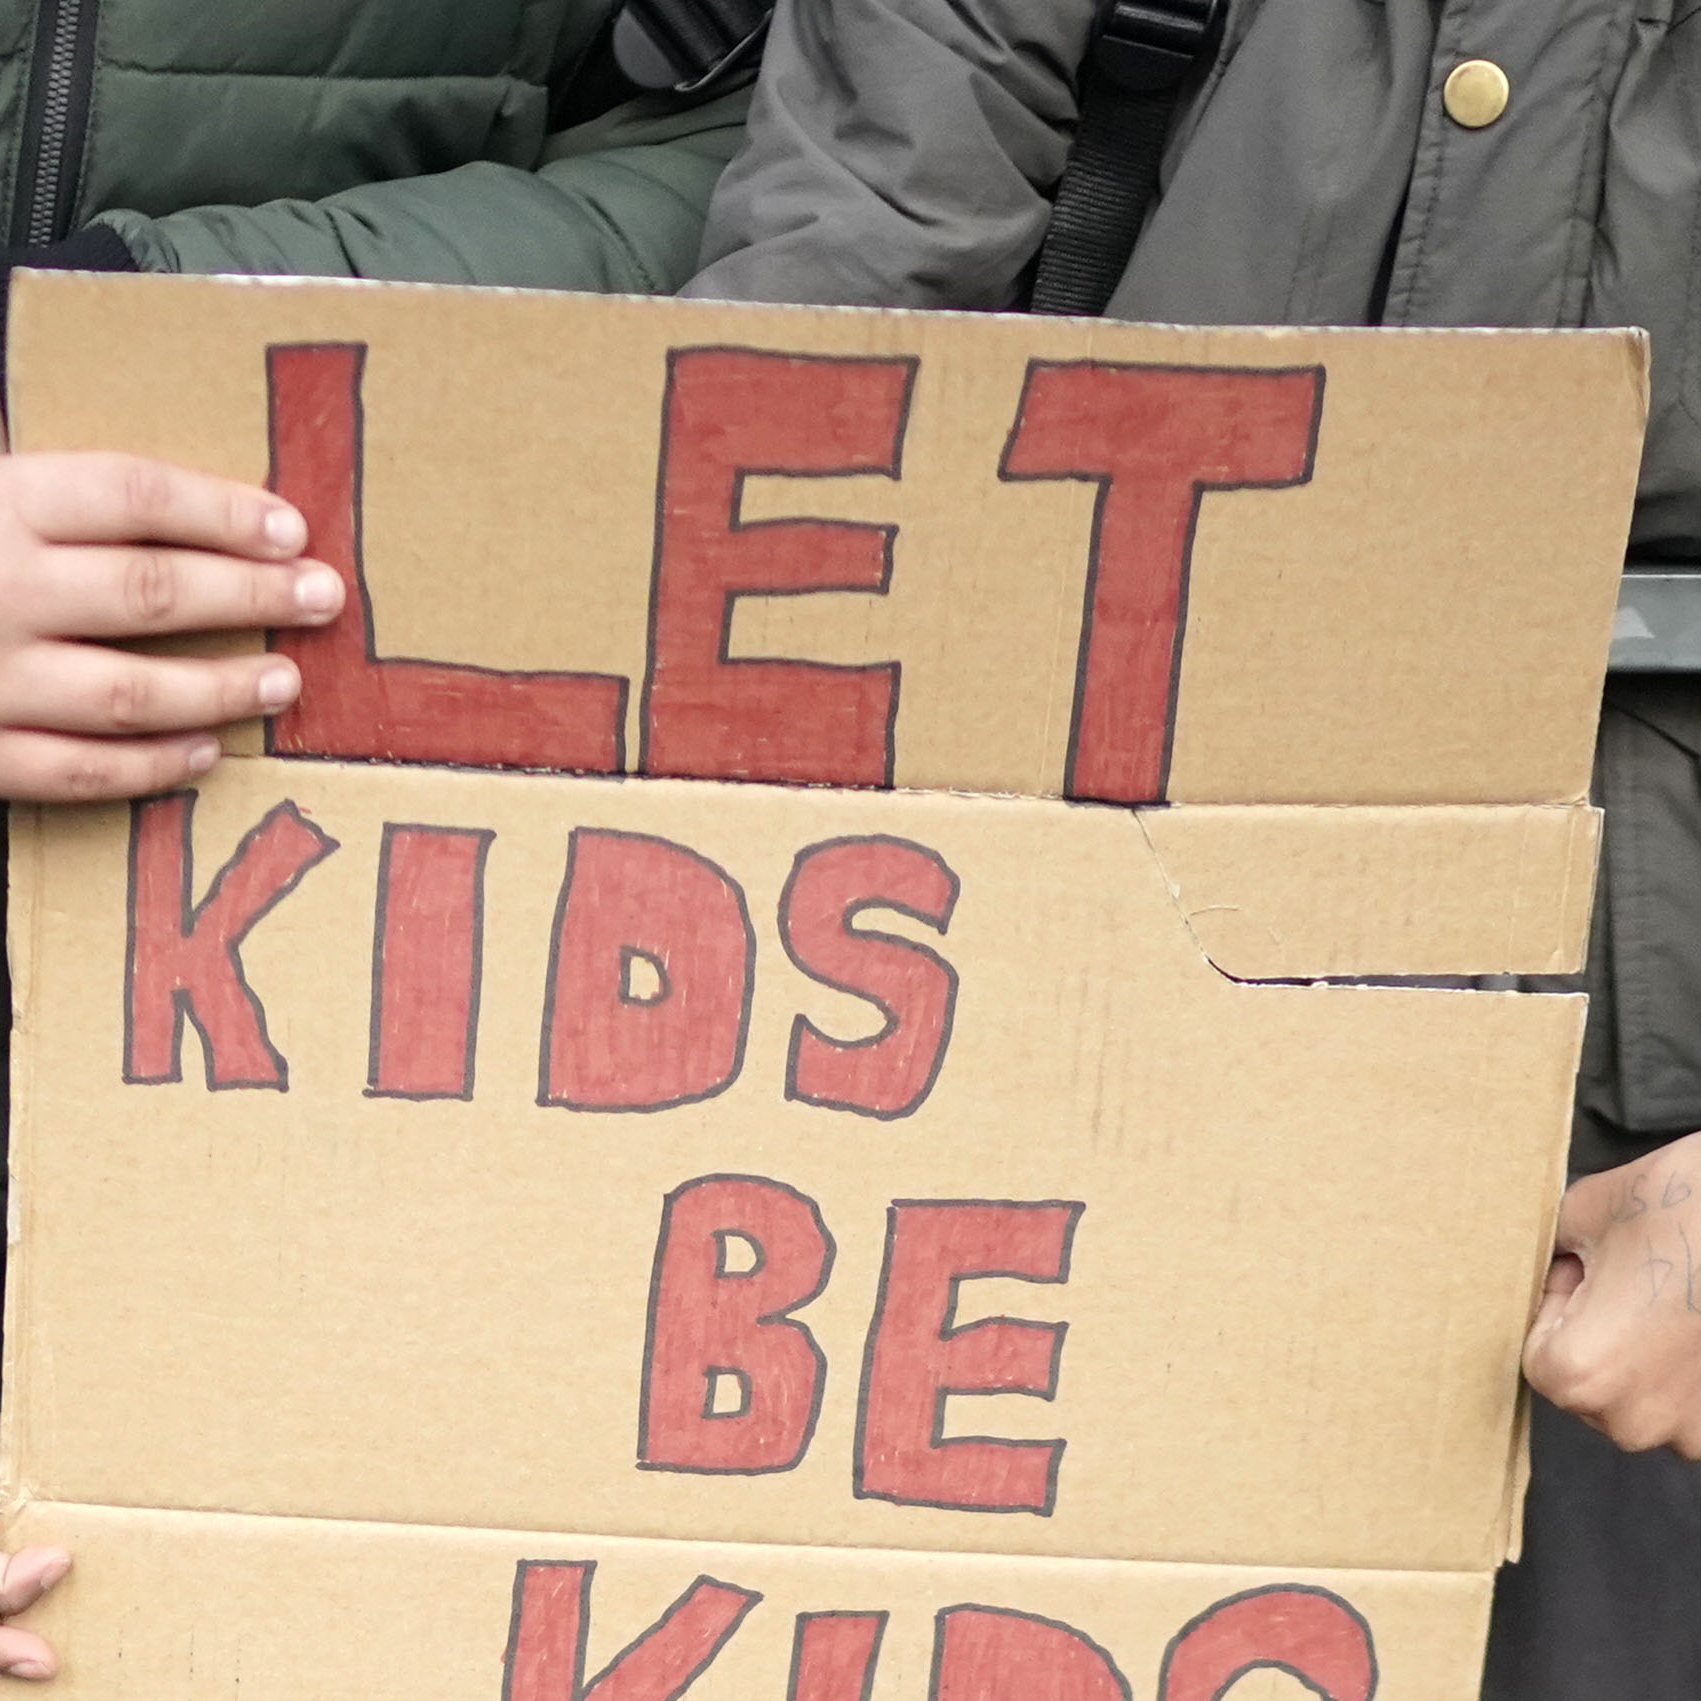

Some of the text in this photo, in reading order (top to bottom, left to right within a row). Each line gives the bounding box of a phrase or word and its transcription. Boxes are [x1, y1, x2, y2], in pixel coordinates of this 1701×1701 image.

[262, 341, 1322, 806] LET
[123, 790, 959, 1118] KIDS
[638, 1174, 1083, 1514] BE
